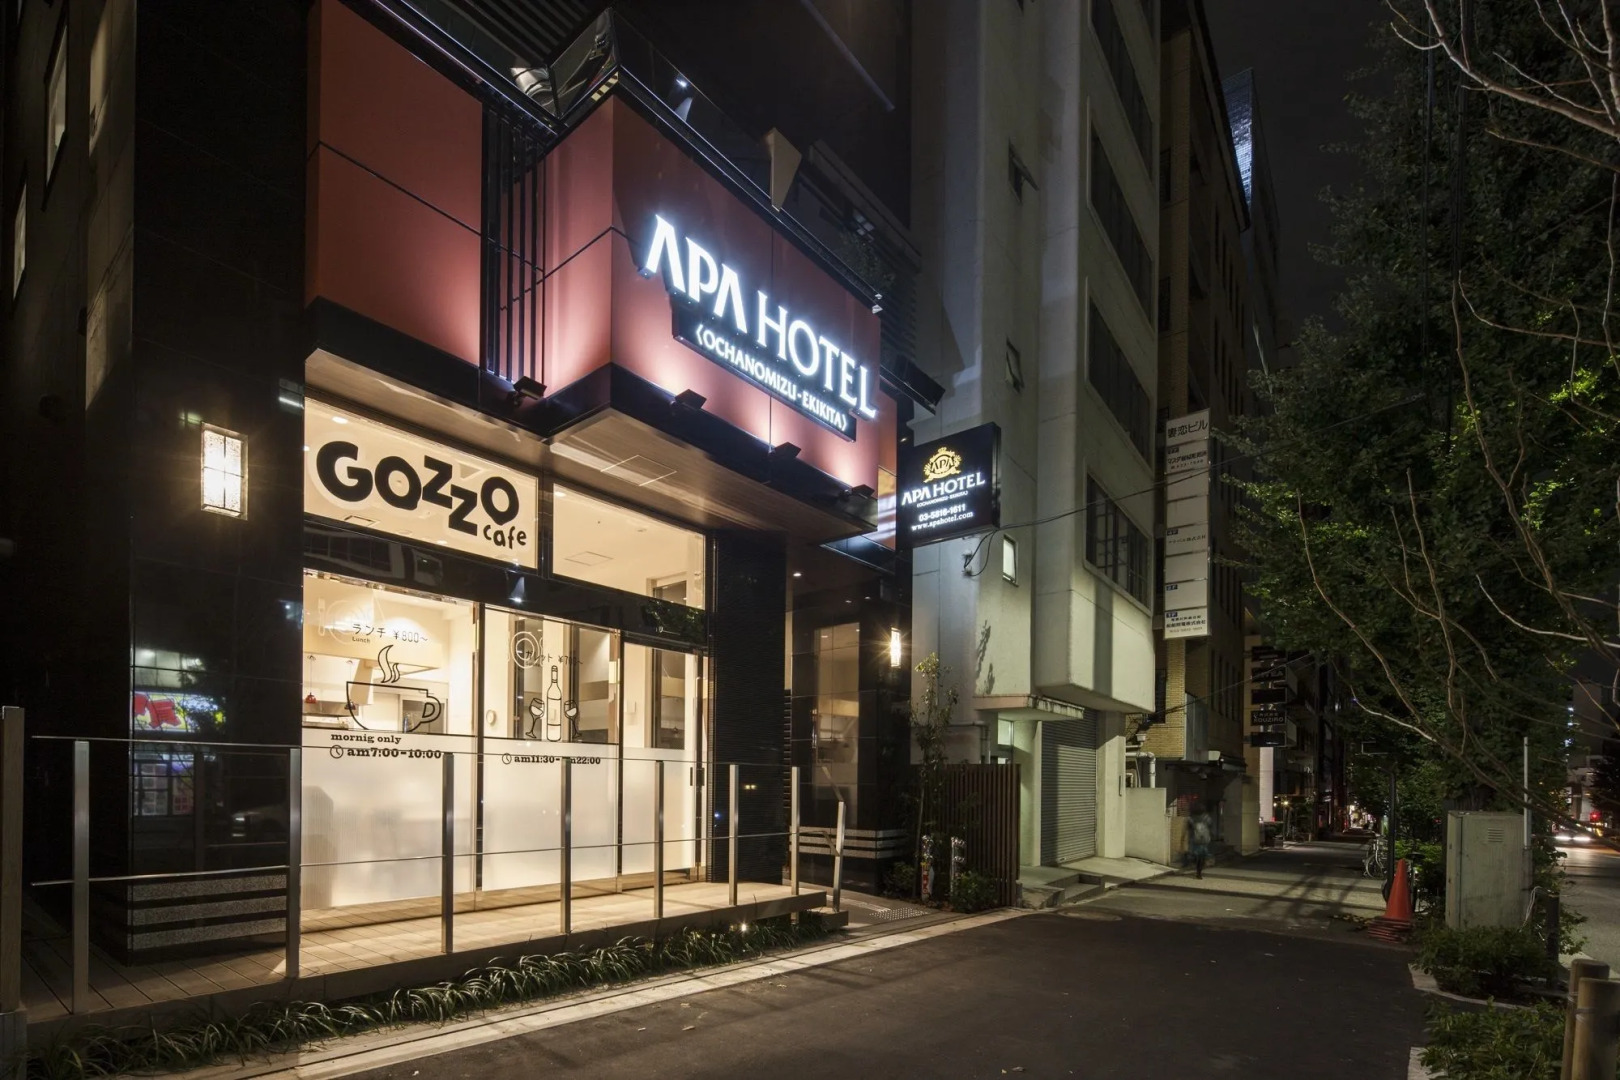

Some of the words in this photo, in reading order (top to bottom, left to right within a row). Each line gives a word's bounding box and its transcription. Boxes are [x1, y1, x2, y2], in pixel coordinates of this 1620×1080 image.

[641, 213, 748, 334] APA
[757, 290, 878, 419] HOTEL
[931, 457, 955, 474] APA
[316, 440, 520, 537] GOZZO
[901, 486, 932, 506] APA
[933, 471, 985, 497] HOTEL
[911, 511, 974, 531] www.apahotel.com
[483, 524, 527, 549] cafe
[352, 623, 386, 638] ランチ
[352, 636, 371, 644] Lunch
[330, 733, 375, 743] mornig
[377, 734, 402, 744] only
[347, 747, 442, 759] am7:00-10:00
